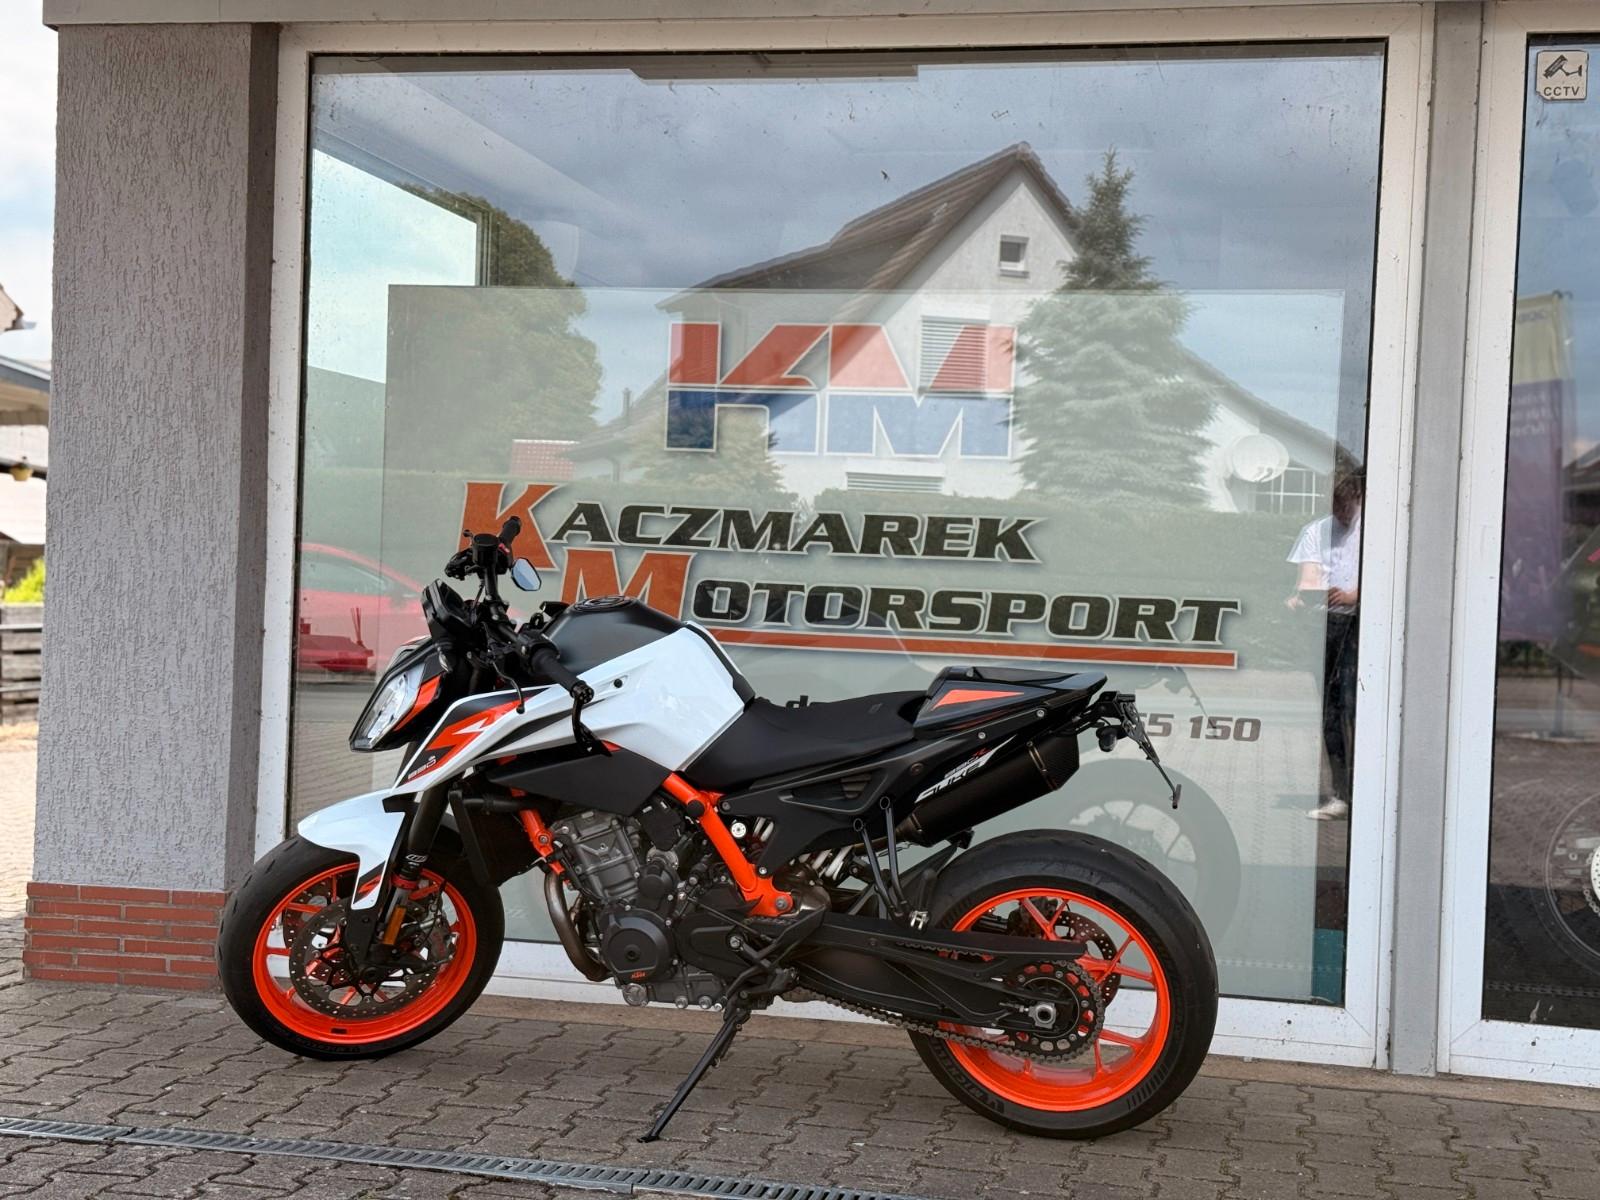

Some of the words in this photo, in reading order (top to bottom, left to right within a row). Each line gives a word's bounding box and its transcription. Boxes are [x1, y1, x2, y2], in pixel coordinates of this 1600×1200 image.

[1543, 86, 1580, 97] CCTV
[665, 322, 1015, 460] KM
[457, 481, 1046, 565] KACZMAREK
[560, 546, 1241, 645] MOTORSPORT
[1189, 715, 1262, 742] 150
